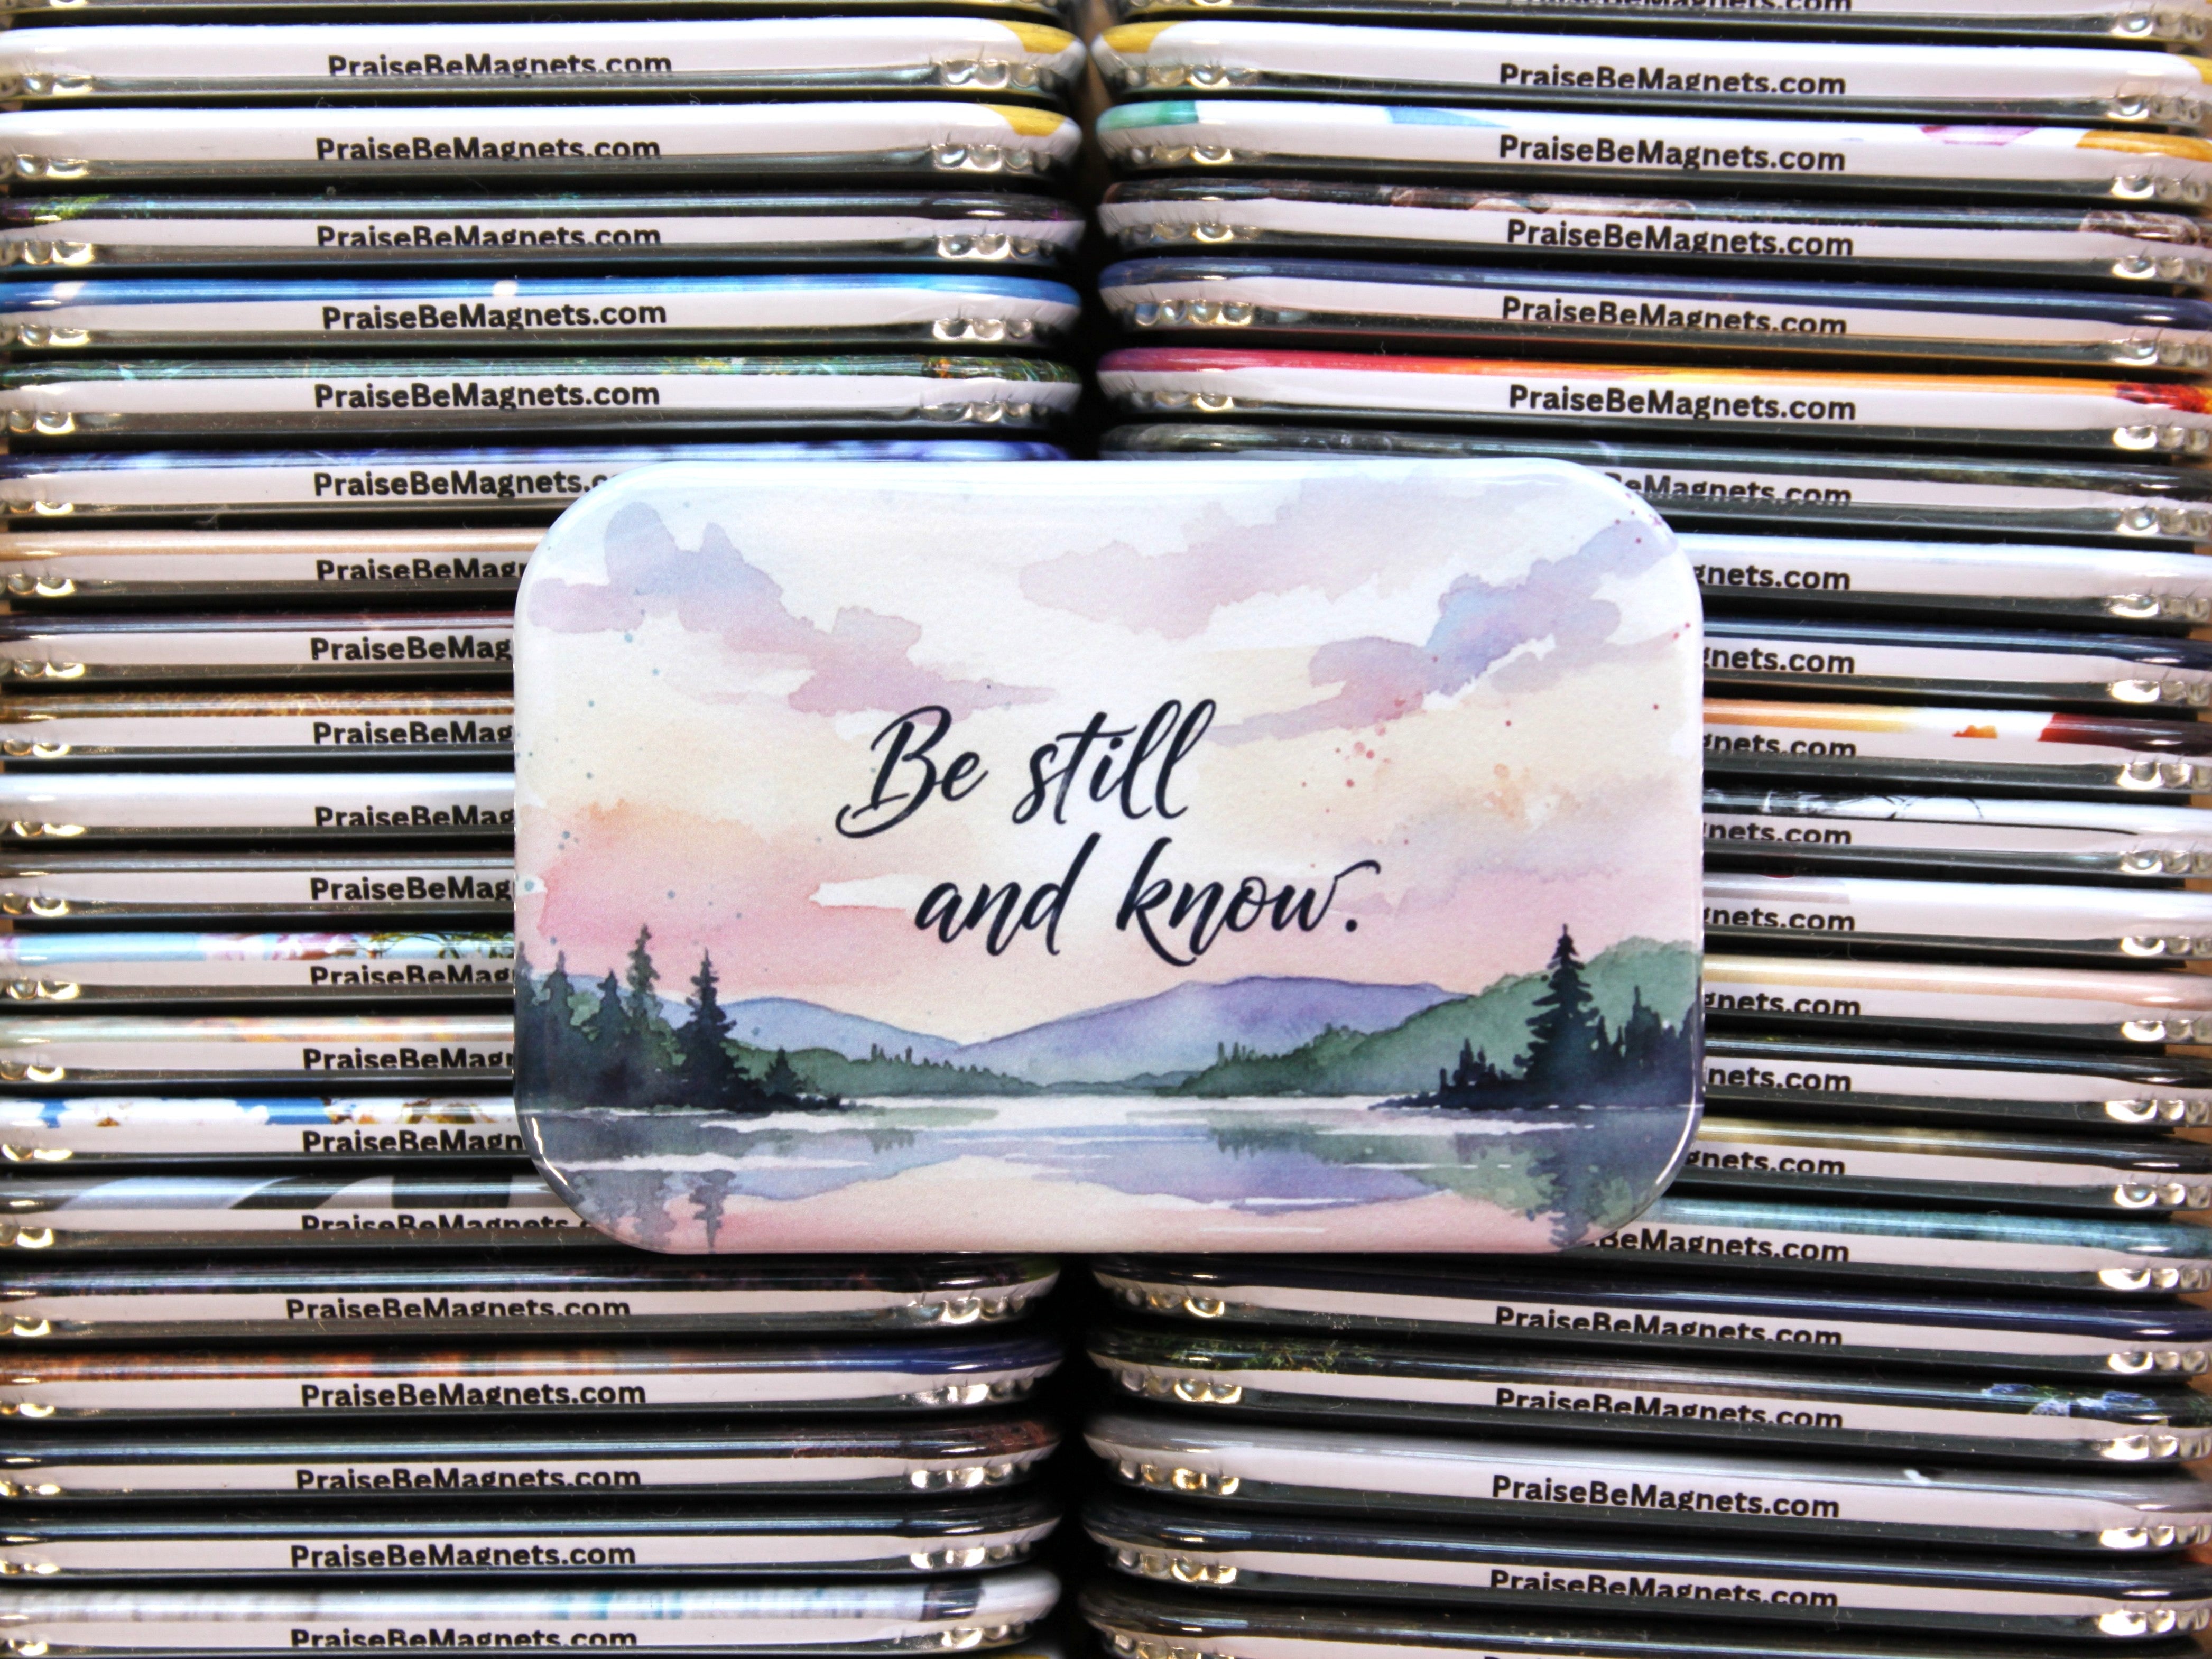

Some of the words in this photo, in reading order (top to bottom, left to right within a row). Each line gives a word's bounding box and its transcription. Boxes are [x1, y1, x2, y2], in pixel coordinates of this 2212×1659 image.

[1500, 63, 1846, 94] PraiseBeMagnets.com
[317, 136, 660, 161] PraiseBeMagnets.com
[1500, 135, 1846, 172] PraiseBeMagnets.com
[317, 224, 661, 248] PraiseBeMagnets.com
[1507, 219, 1854, 256] PraiseBeMagnets.com
[322, 303, 667, 330] PraiseBeMagnets.com
[1503, 296, 1847, 333] PraiseBeMagnets.com
[315, 383, 660, 411] PraiseBeMagnets.com
[1509, 384, 1856, 420] PraiseBeMagnets.com
[314, 470, 616, 497] PraiseBeMagnets.c
[836, 705, 988, 838] Be
[1012, 698, 1217, 824] still
[1703, 822, 1852, 844] nets.com
[310, 876, 513, 901] PraiseBeMag
[914, 832, 1101, 956] and
[1116, 837, 1381, 967] know.
[310, 965, 513, 985] PraiseBeMag
[303, 1048, 513, 1070] PraiseBeMag
[1707, 1065, 1852, 1092] nets.com
[1587, 1228, 1849, 1262] BeMagnets.com
[301, 1384, 646, 1407] PraiseBeMagnets.com
[296, 1468, 641, 1489] PraiseBeMagnets.com
[1493, 1475, 1839, 1517] PraiseBeMagnets.com
[291, 1544, 635, 1568] PraiseBeMagnets.com
